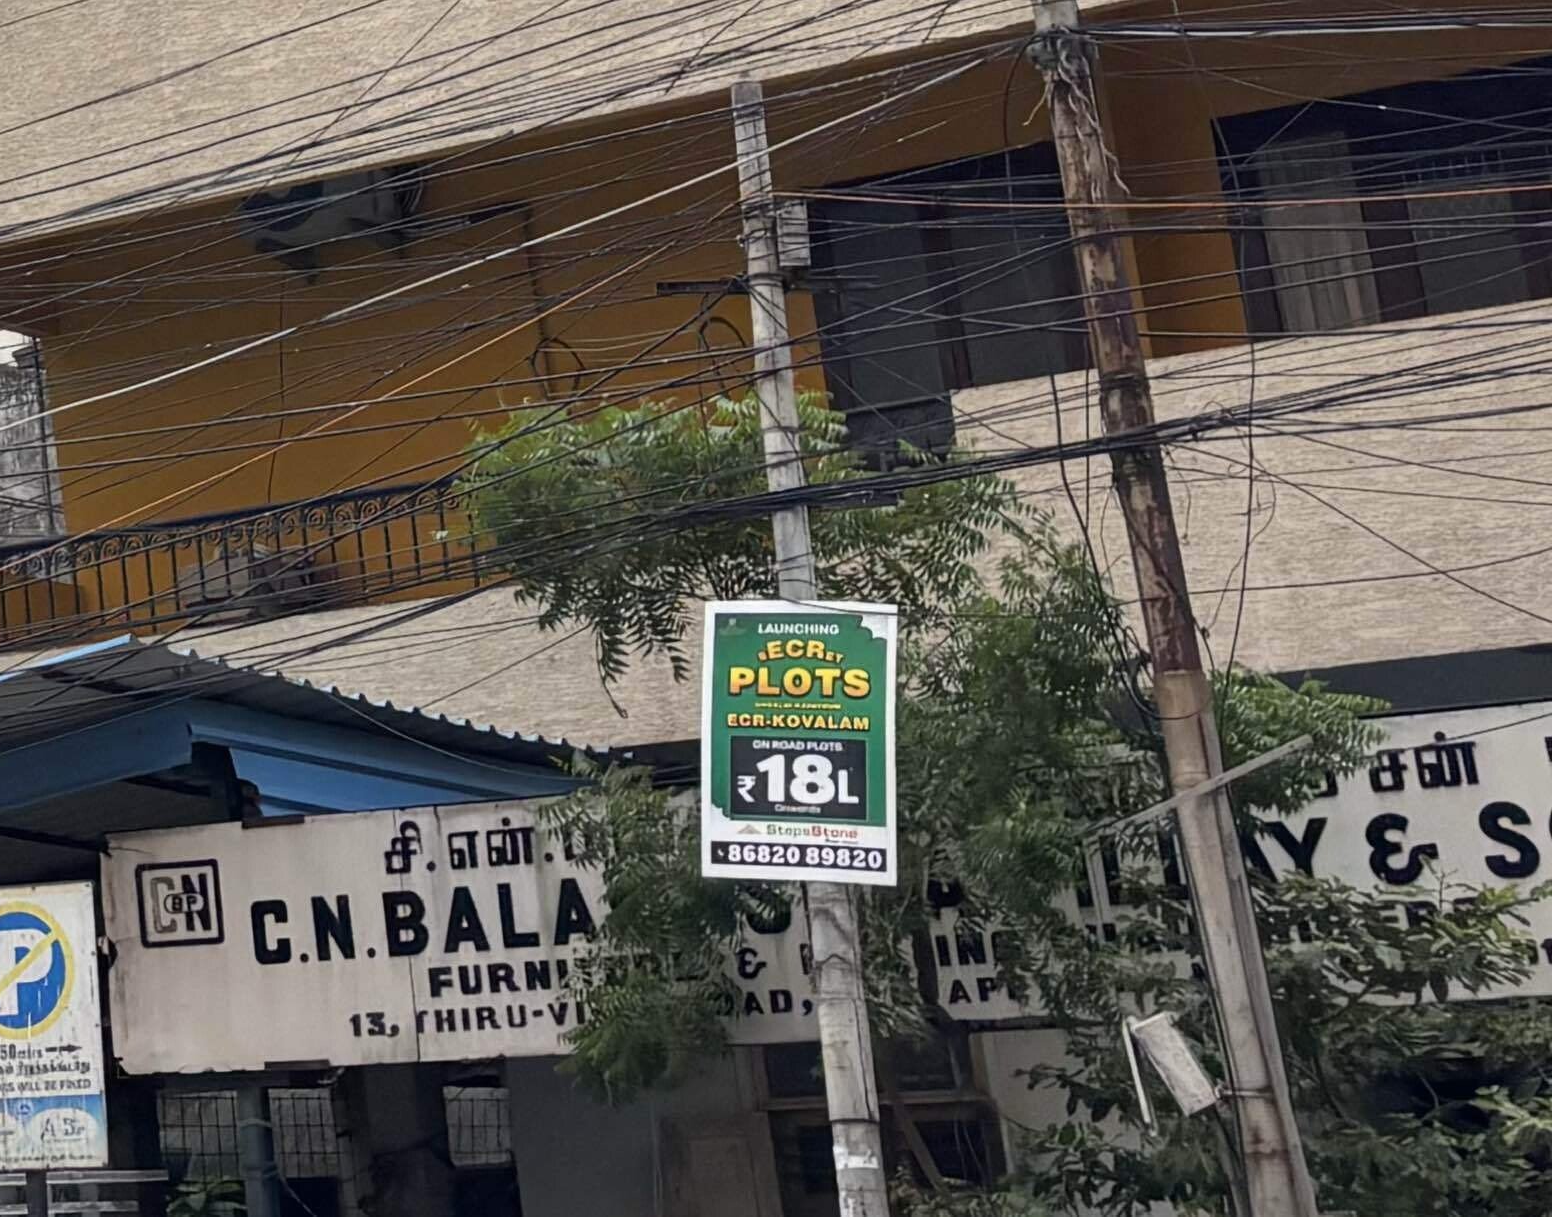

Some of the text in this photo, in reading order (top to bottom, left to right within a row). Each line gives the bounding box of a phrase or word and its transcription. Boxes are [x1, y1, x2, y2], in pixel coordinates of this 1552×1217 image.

[757, 623, 840, 635] LAUNCHING
[728, 667, 871, 699] PLOTS
[727, 713, 870, 731] ECR-KOVALAM
[752, 740, 843, 752] ON ROAD PLOTS
[1365, 813, 1440, 884] &
[1479, 801, 1552, 879] S
[728, 844, 883, 869] 86820 89820
[736, 947, 766, 980] &
[349, 1011, 400, 1037] 13,
